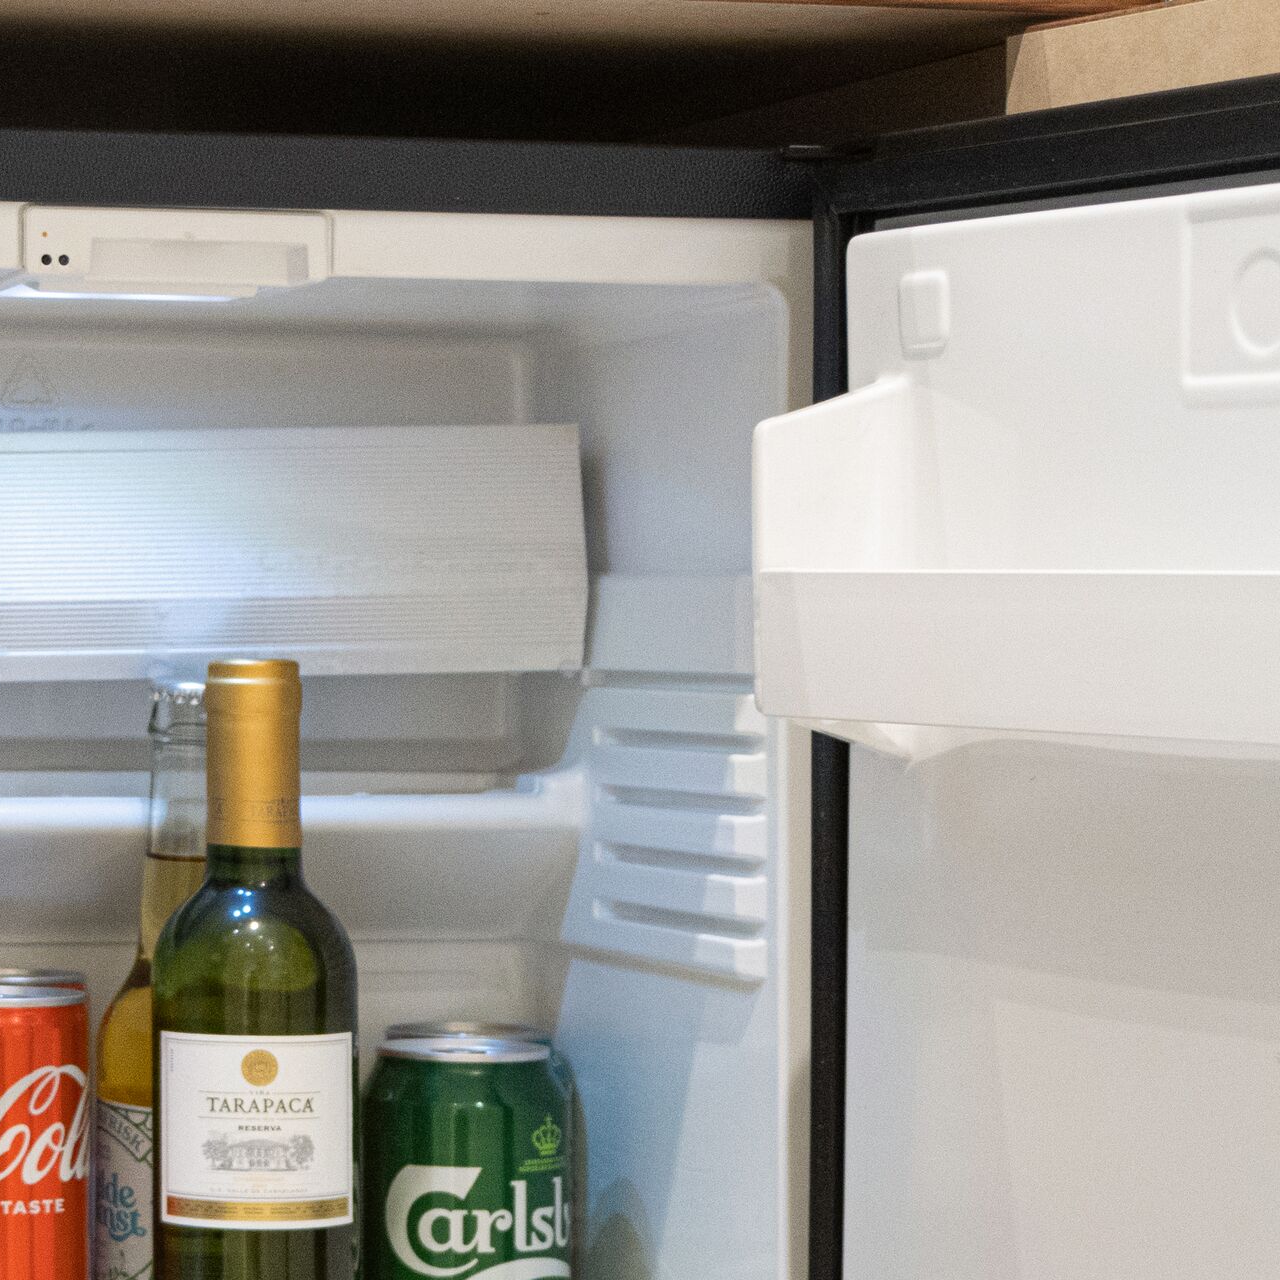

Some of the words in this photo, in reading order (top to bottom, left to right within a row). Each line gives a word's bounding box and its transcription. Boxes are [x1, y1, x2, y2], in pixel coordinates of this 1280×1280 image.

[237, 1124, 283, 1132] RESERVA
[103, 1172, 137, 1209] de
[0, 1197, 65, 1216] TASTE
